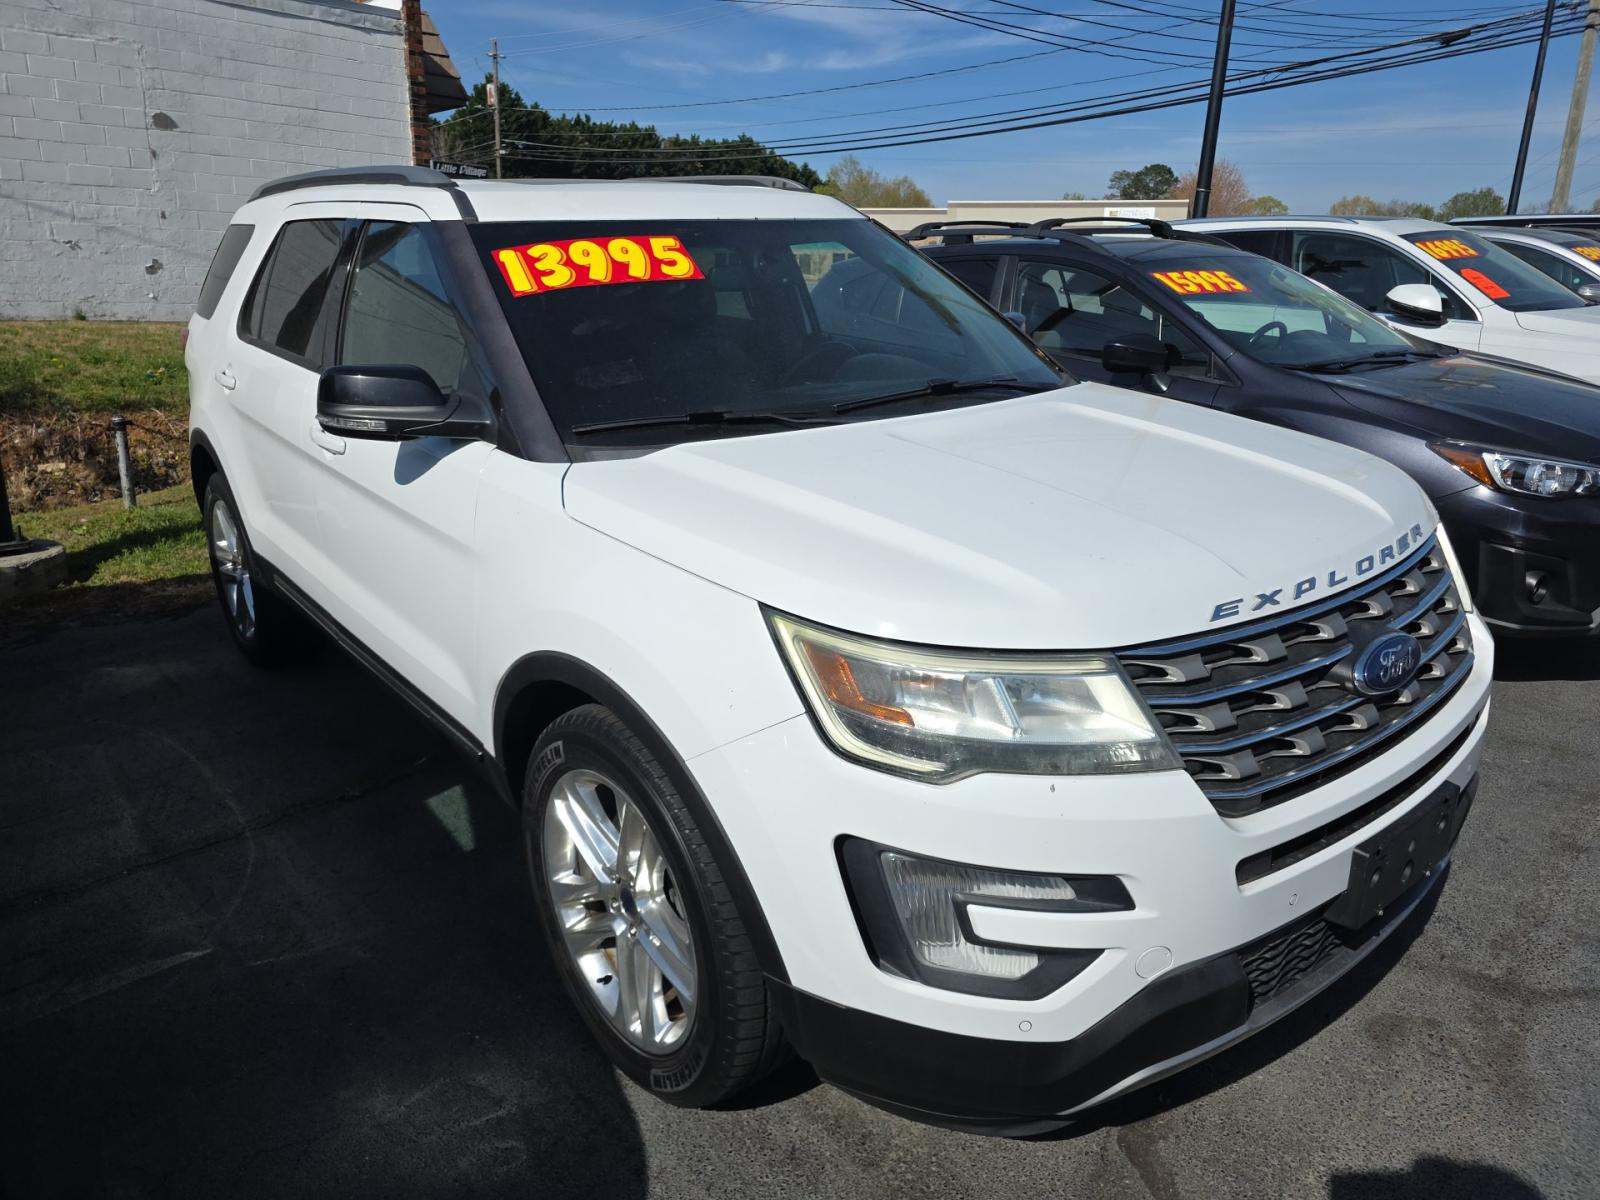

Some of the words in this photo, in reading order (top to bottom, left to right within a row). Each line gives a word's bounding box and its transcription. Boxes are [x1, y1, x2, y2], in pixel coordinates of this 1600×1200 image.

[499, 237, 695, 293] 13995
[1414, 239, 1479, 260] 16995
[1151, 270, 1248, 296] 15995
[1209, 523, 1424, 622] EXPLORER
[1380, 644, 1413, 684] Ford
